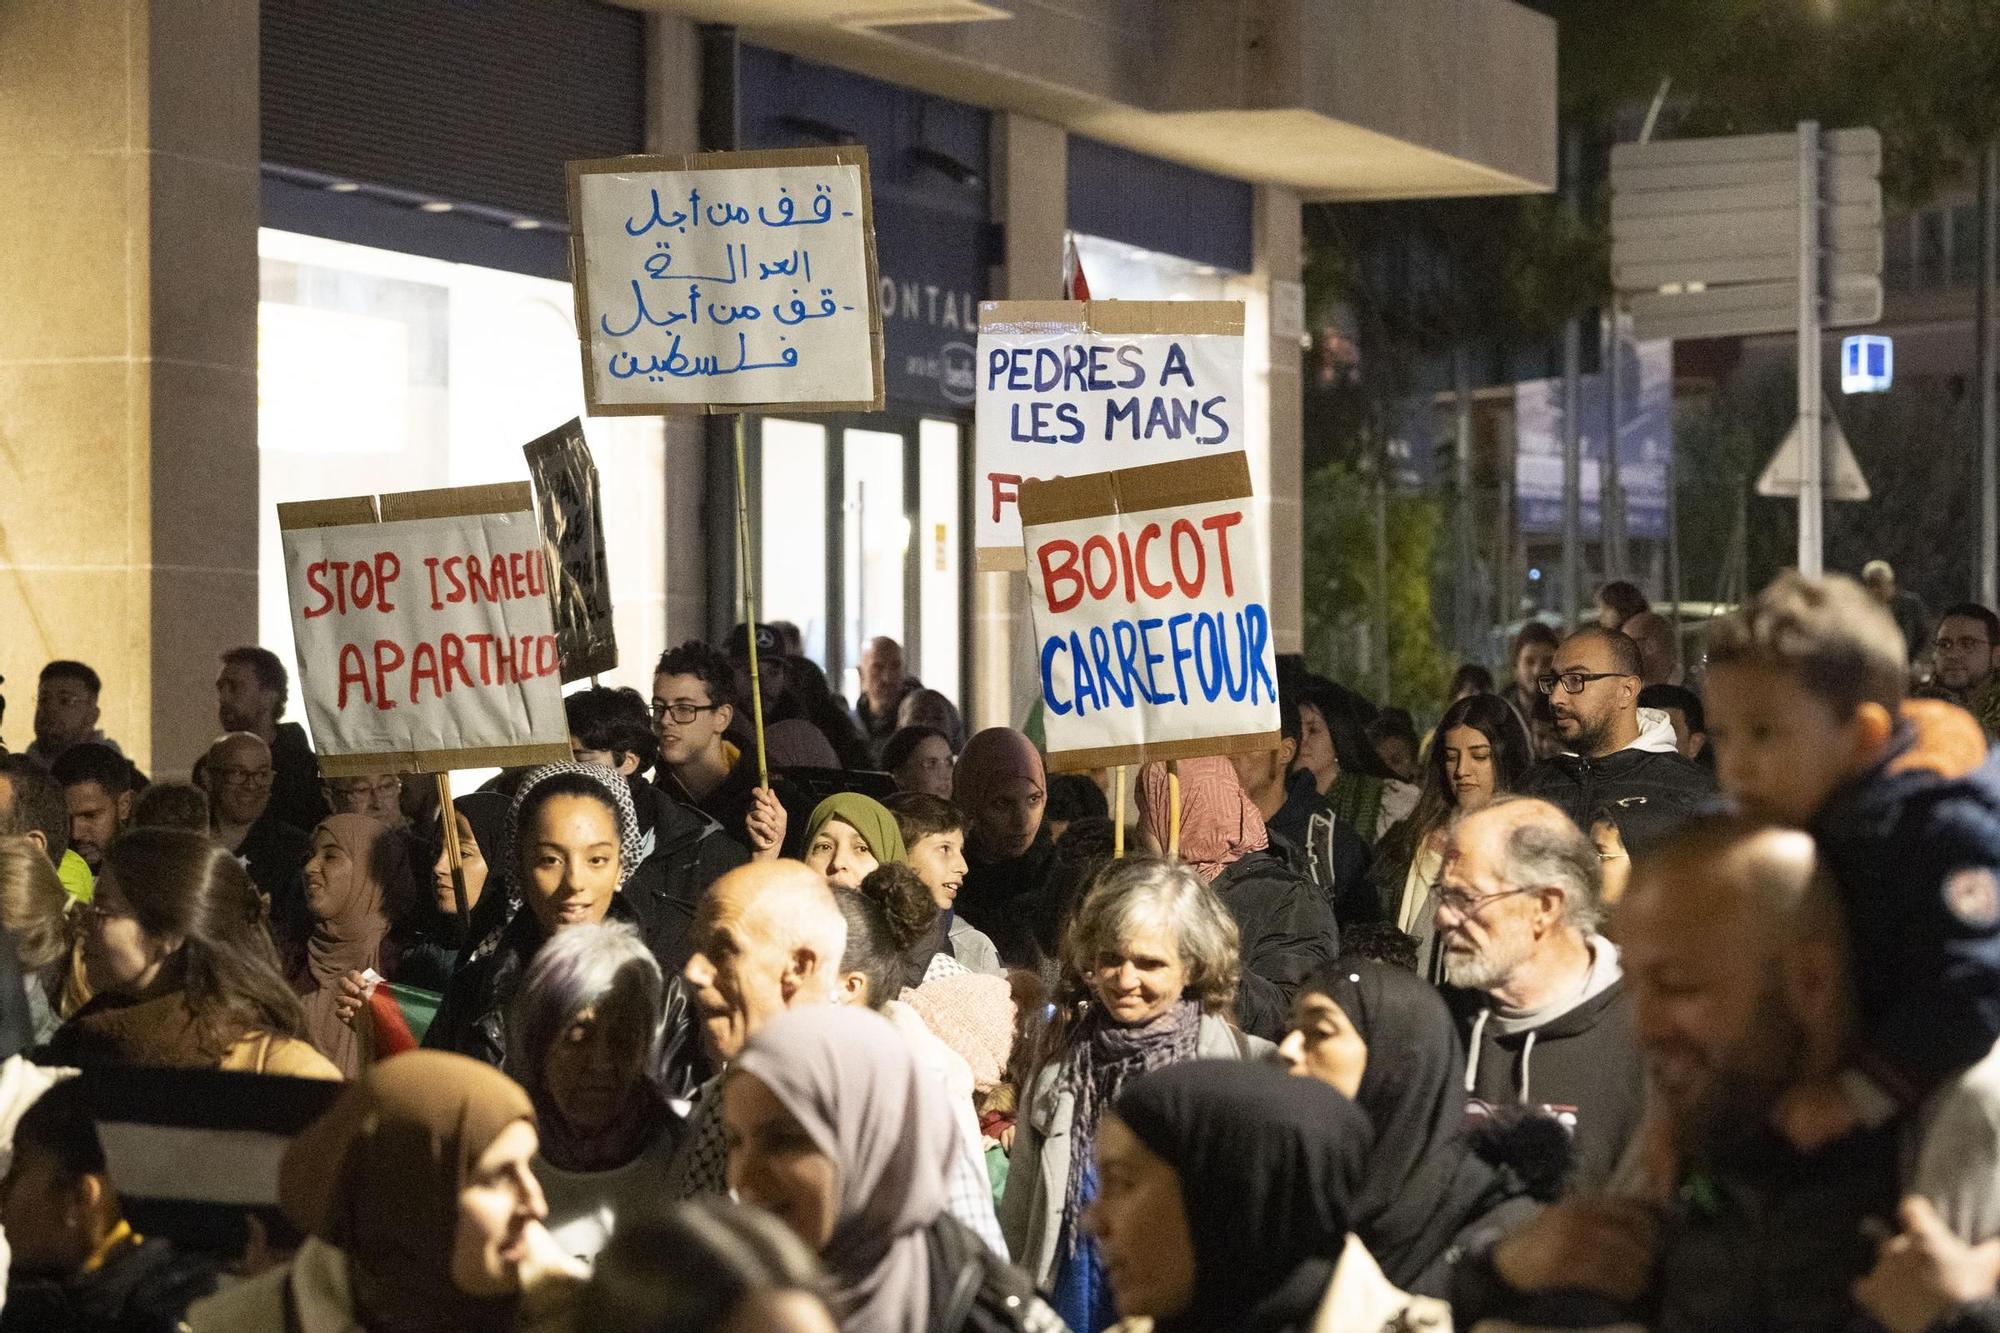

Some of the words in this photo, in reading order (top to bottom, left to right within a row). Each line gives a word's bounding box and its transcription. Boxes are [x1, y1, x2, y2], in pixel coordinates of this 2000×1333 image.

[625, 188, 700, 237] أجل
[706, 202, 750, 227] من
[601, 280, 700, 337] أجل
[708, 303, 761, 325] من
[773, 288, 837, 325] قف
[608, 332, 798, 382] فلسطين
[988, 345, 1146, 392] PEDRES
[1160, 343, 1195, 388] A
[1010, 402, 1086, 445] LES
[1104, 395, 1229, 445] MANS
[303, 551, 401, 619] STOP
[1036, 511, 1243, 614] BOICOT
[337, 633, 560, 711] APARTHID
[1040, 603, 1277, 717] CARREFOUR
